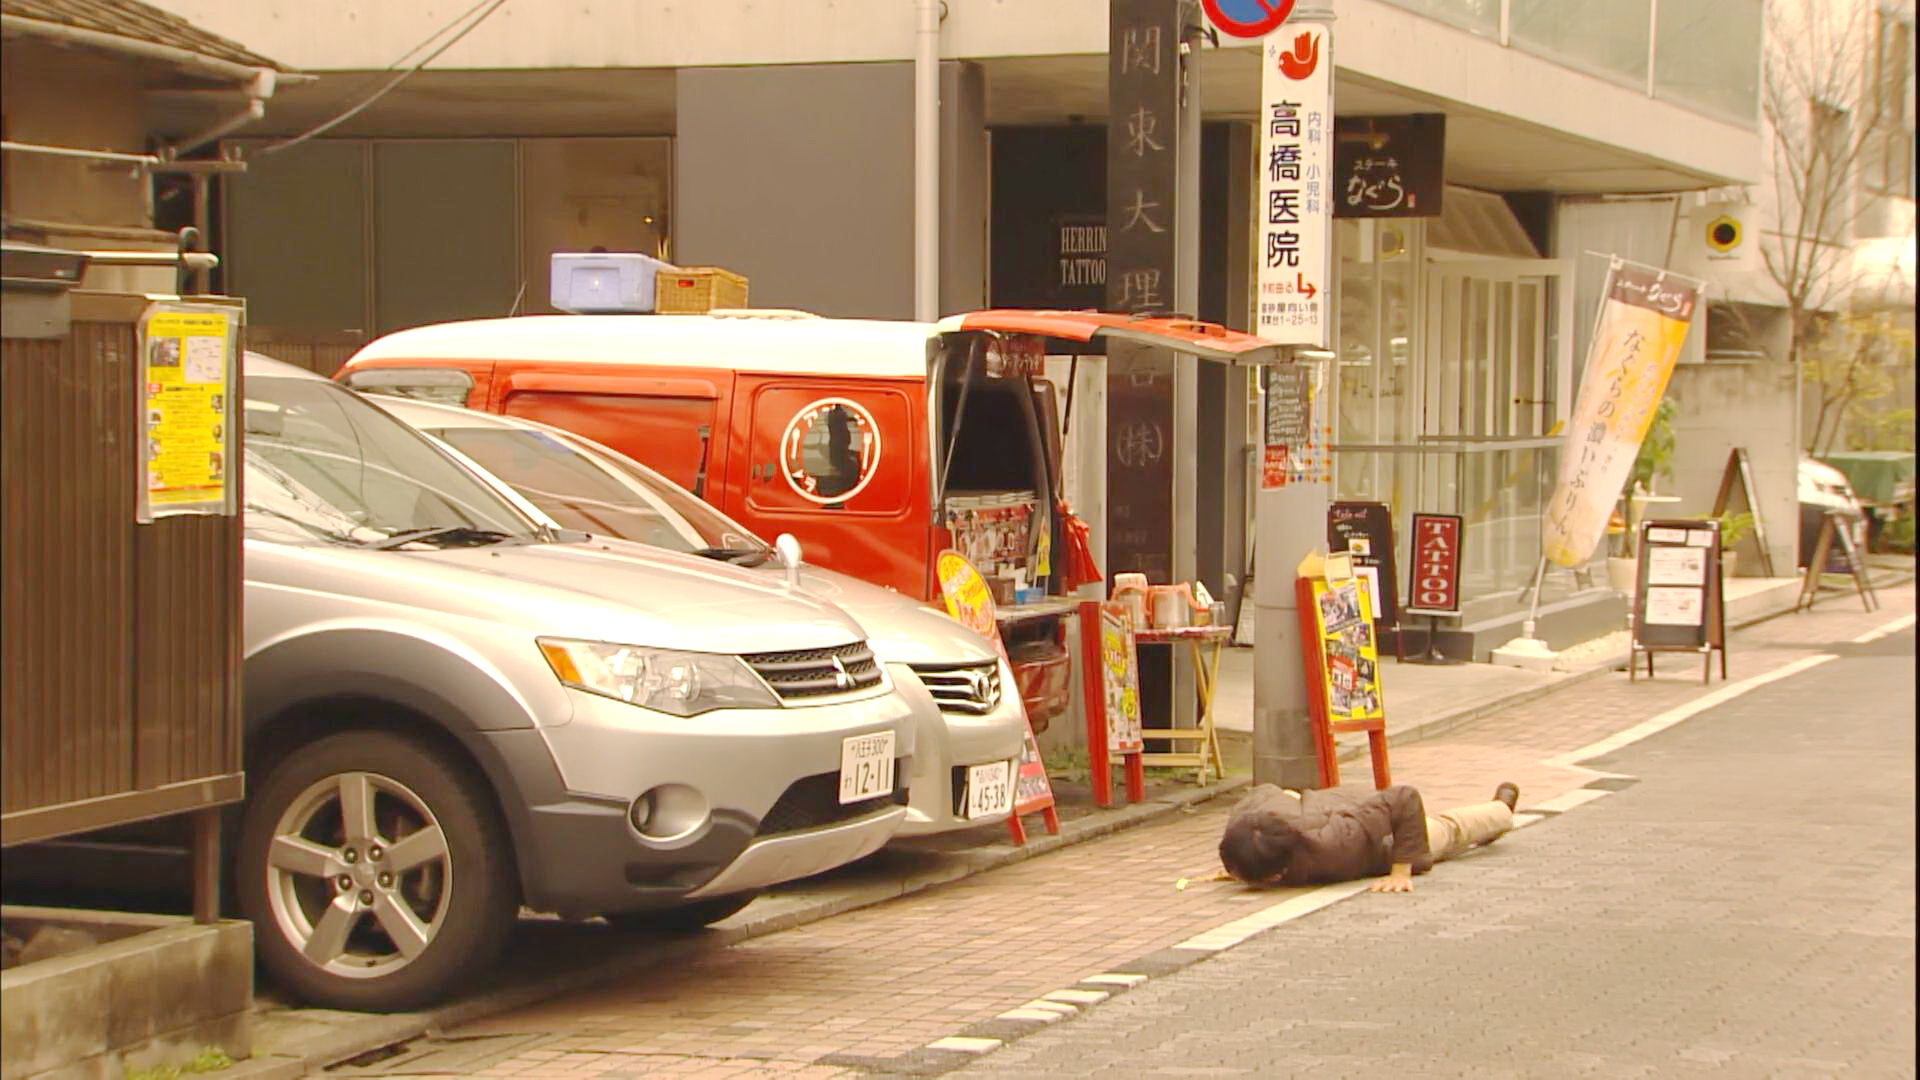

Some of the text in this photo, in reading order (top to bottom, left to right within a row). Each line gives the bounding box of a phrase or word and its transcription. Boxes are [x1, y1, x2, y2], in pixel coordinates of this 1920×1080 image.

[1268, 99, 1302, 268] 高橋医院
[1306, 111, 1322, 215] 内科・小児科
[1347, 175, 1404, 210] なぐら
[1060, 259, 1106, 285] TATTOO
[1420, 521, 1451, 605] TATTOO
